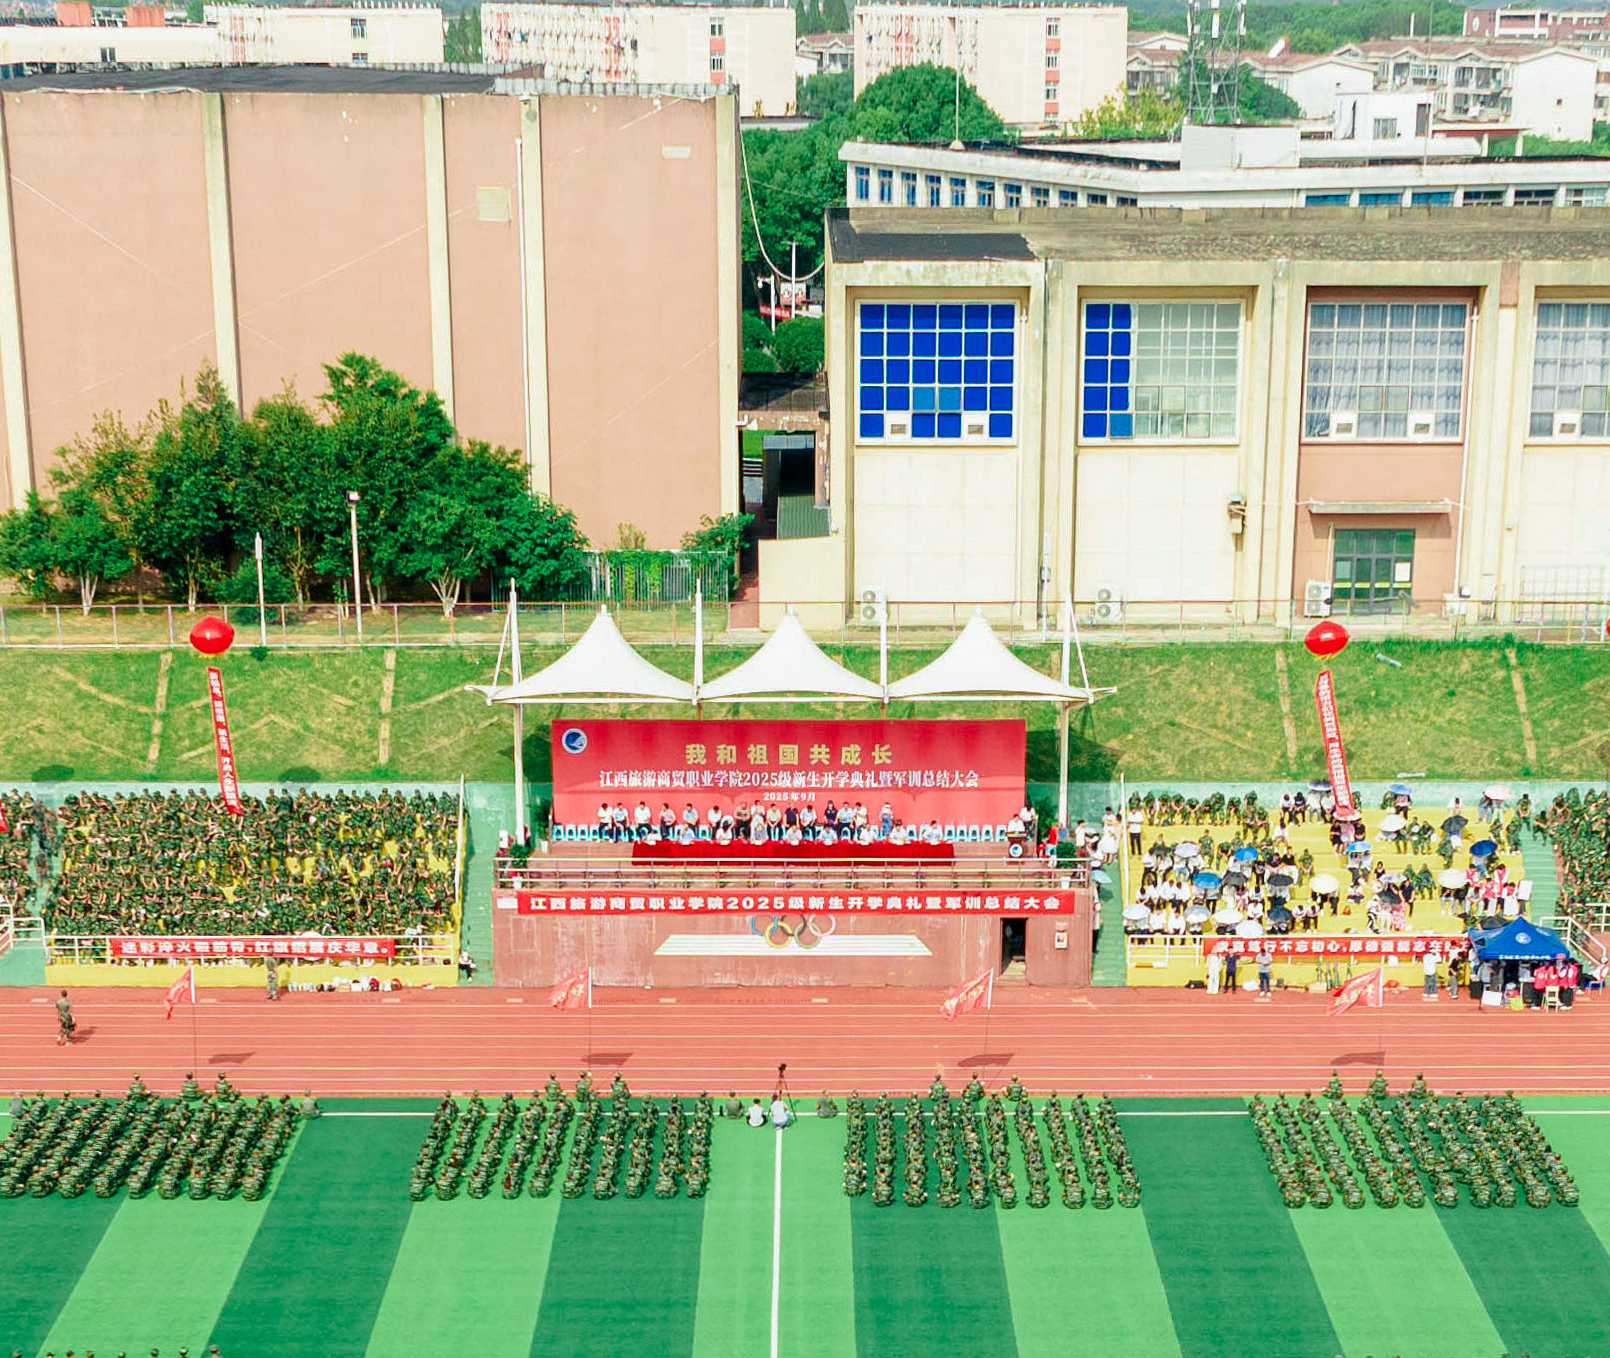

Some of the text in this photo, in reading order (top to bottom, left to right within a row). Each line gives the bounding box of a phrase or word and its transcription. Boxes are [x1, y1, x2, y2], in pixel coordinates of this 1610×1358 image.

[686, 744, 892, 765] 我和祖国共成长
[600, 770, 979, 788] 江西旅游商贸职业学院2025级新生开学典礼暨军训总结大会
[763, 792, 816, 801] 2025年9月
[531, 897, 1060, 910] 江西旅游商贸职业学院2025级新生开学典礼暨军训总结大会
